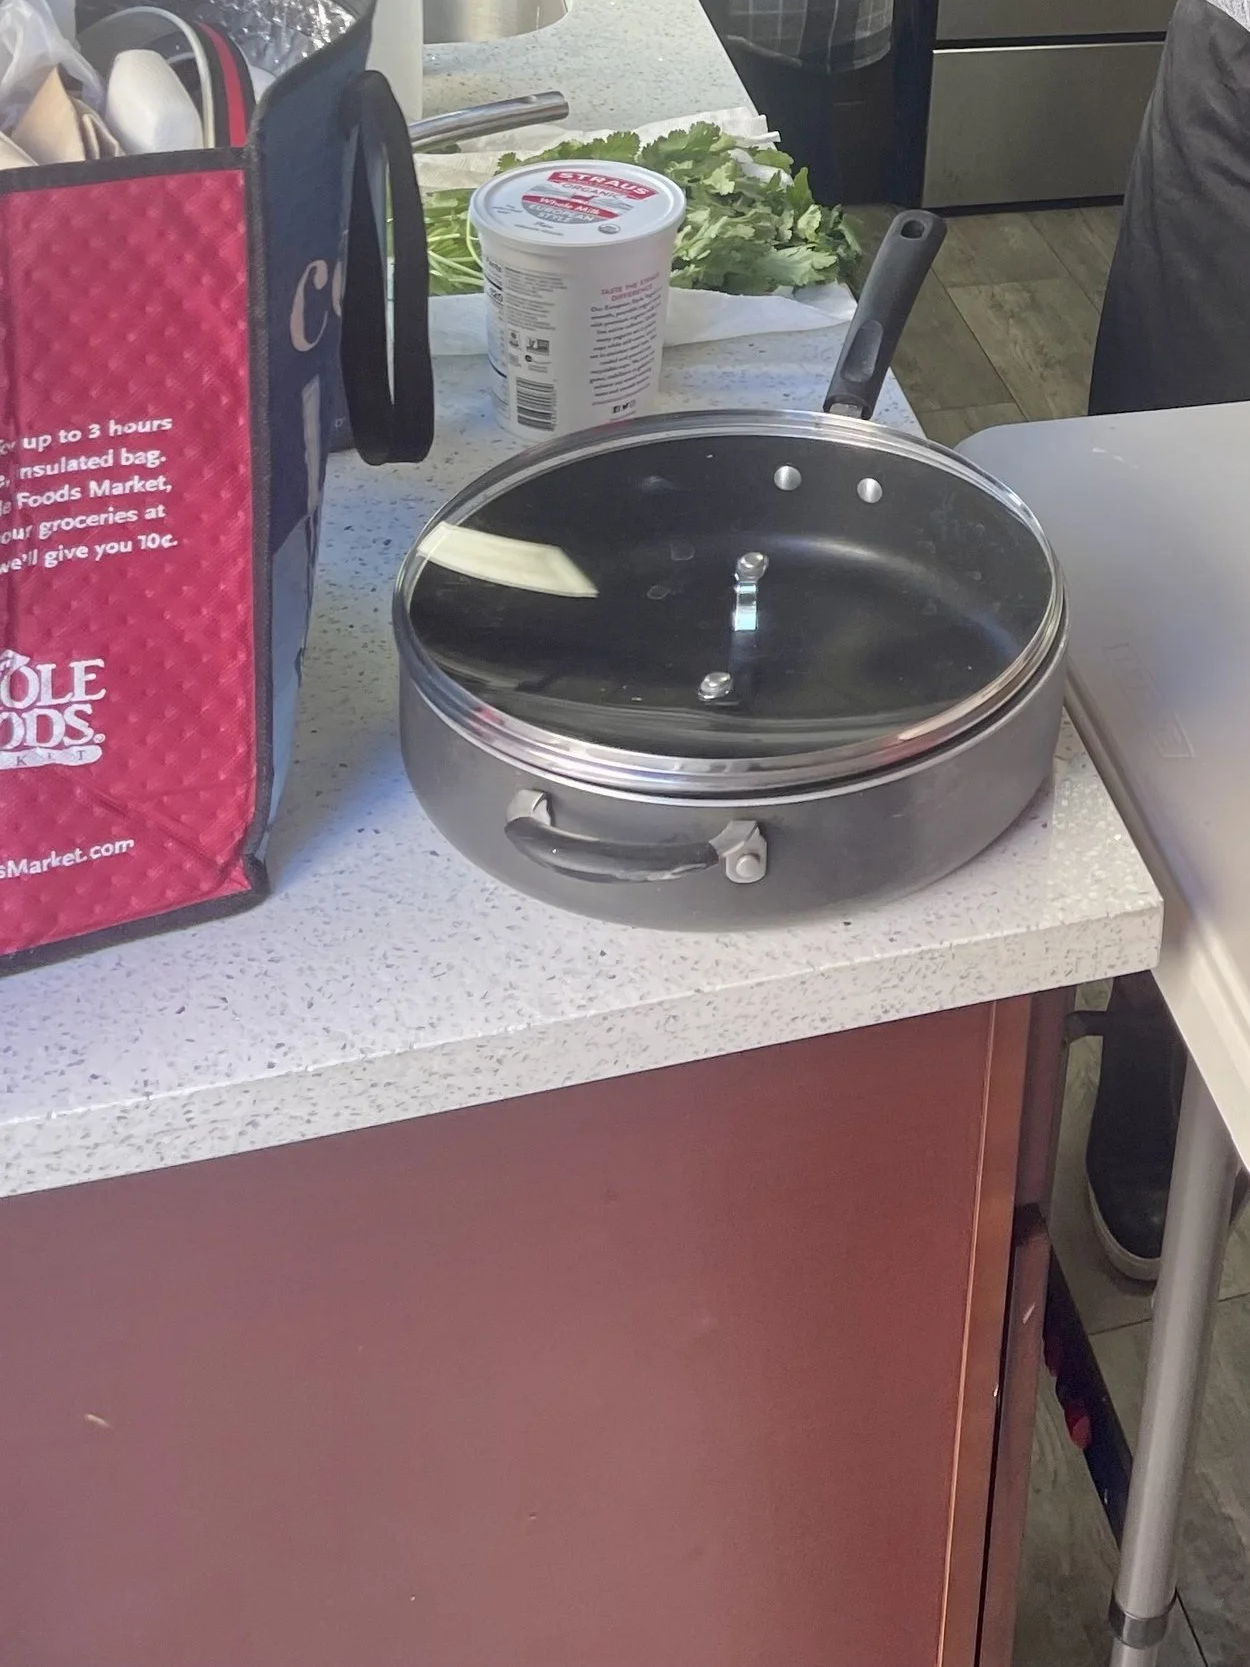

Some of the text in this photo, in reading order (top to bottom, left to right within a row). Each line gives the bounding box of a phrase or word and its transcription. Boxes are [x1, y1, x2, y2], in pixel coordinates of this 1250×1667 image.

[557, 171, 650, 196] STRAUS
[561, 182, 621, 200] ORGANIC
[528, 203, 595, 222] EUROPEAN
[536, 211, 572, 223] STYLE
[539, 196, 601, 216] Whole Milk
[22, 435, 52, 452] up
[59, 429, 82, 444] to
[88, 423, 101, 439] 3
[109, 418, 173, 437] hours
[20, 448, 166, 480] nsulated bag.
[16, 484, 82, 509] Foods
[89, 475, 173, 499] Market,
[0, 504, 166, 544] our groceries at
[44, 544, 89, 568] give
[95, 540, 132, 562] you
[0, 658, 106, 710] OLE
[0, 839, 135, 879] sMarket.com
